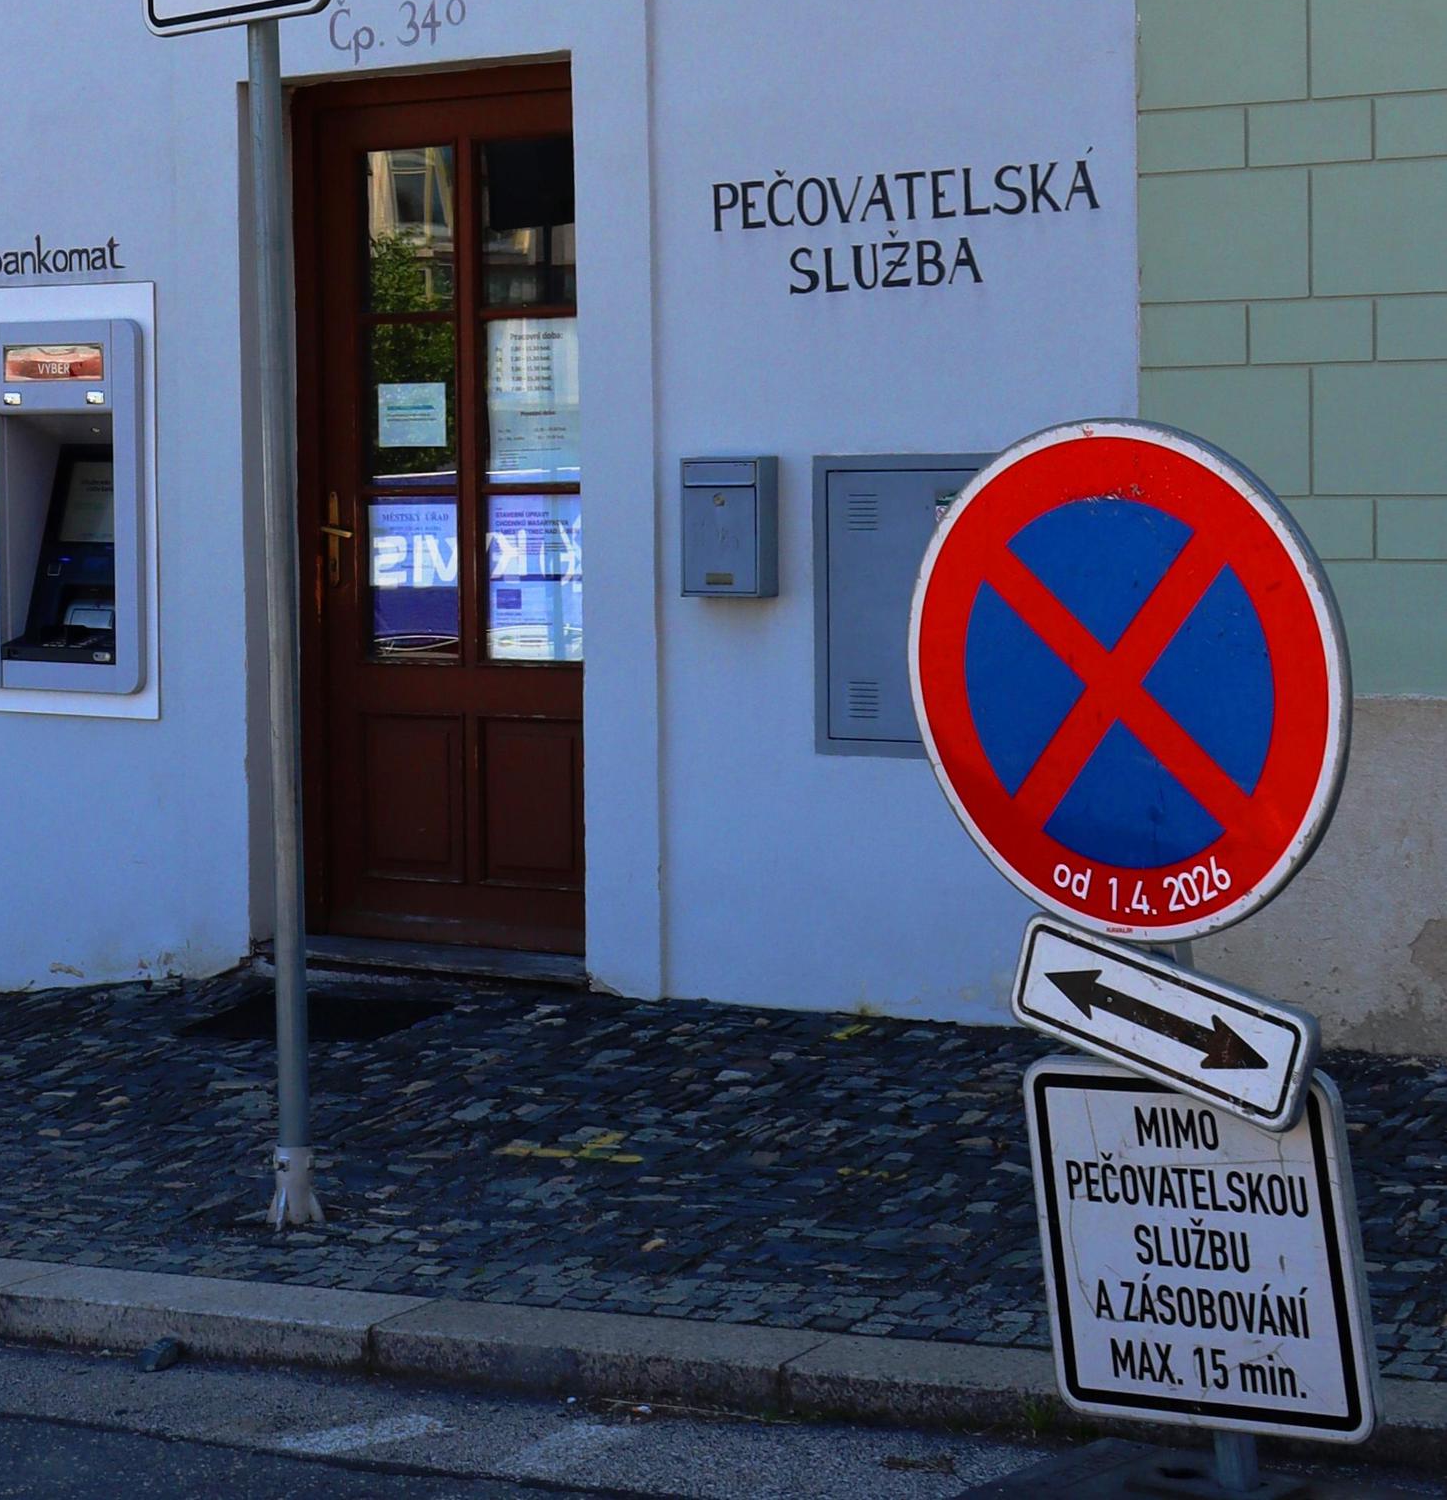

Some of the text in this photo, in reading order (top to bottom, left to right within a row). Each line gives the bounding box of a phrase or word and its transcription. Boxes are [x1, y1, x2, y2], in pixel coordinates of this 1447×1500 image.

[712, 146, 1100, 232] PEČOVATELSKÁ
[789, 230, 983, 295] SLUŽBA
[1053, 863, 1092, 900] od
[1162, 856, 1232, 912] 2026
[1133, 1105, 1219, 1151] MIMO
[1066, 1152, 1309, 1218] PEČOVATELSKOU
[1134, 1218, 1250, 1273] SLUŽBU
[1096, 1273, 1310, 1339] A ZÁSOBOVÁNÍ
[1110, 1337, 1307, 1399] MAX. 15 min.
